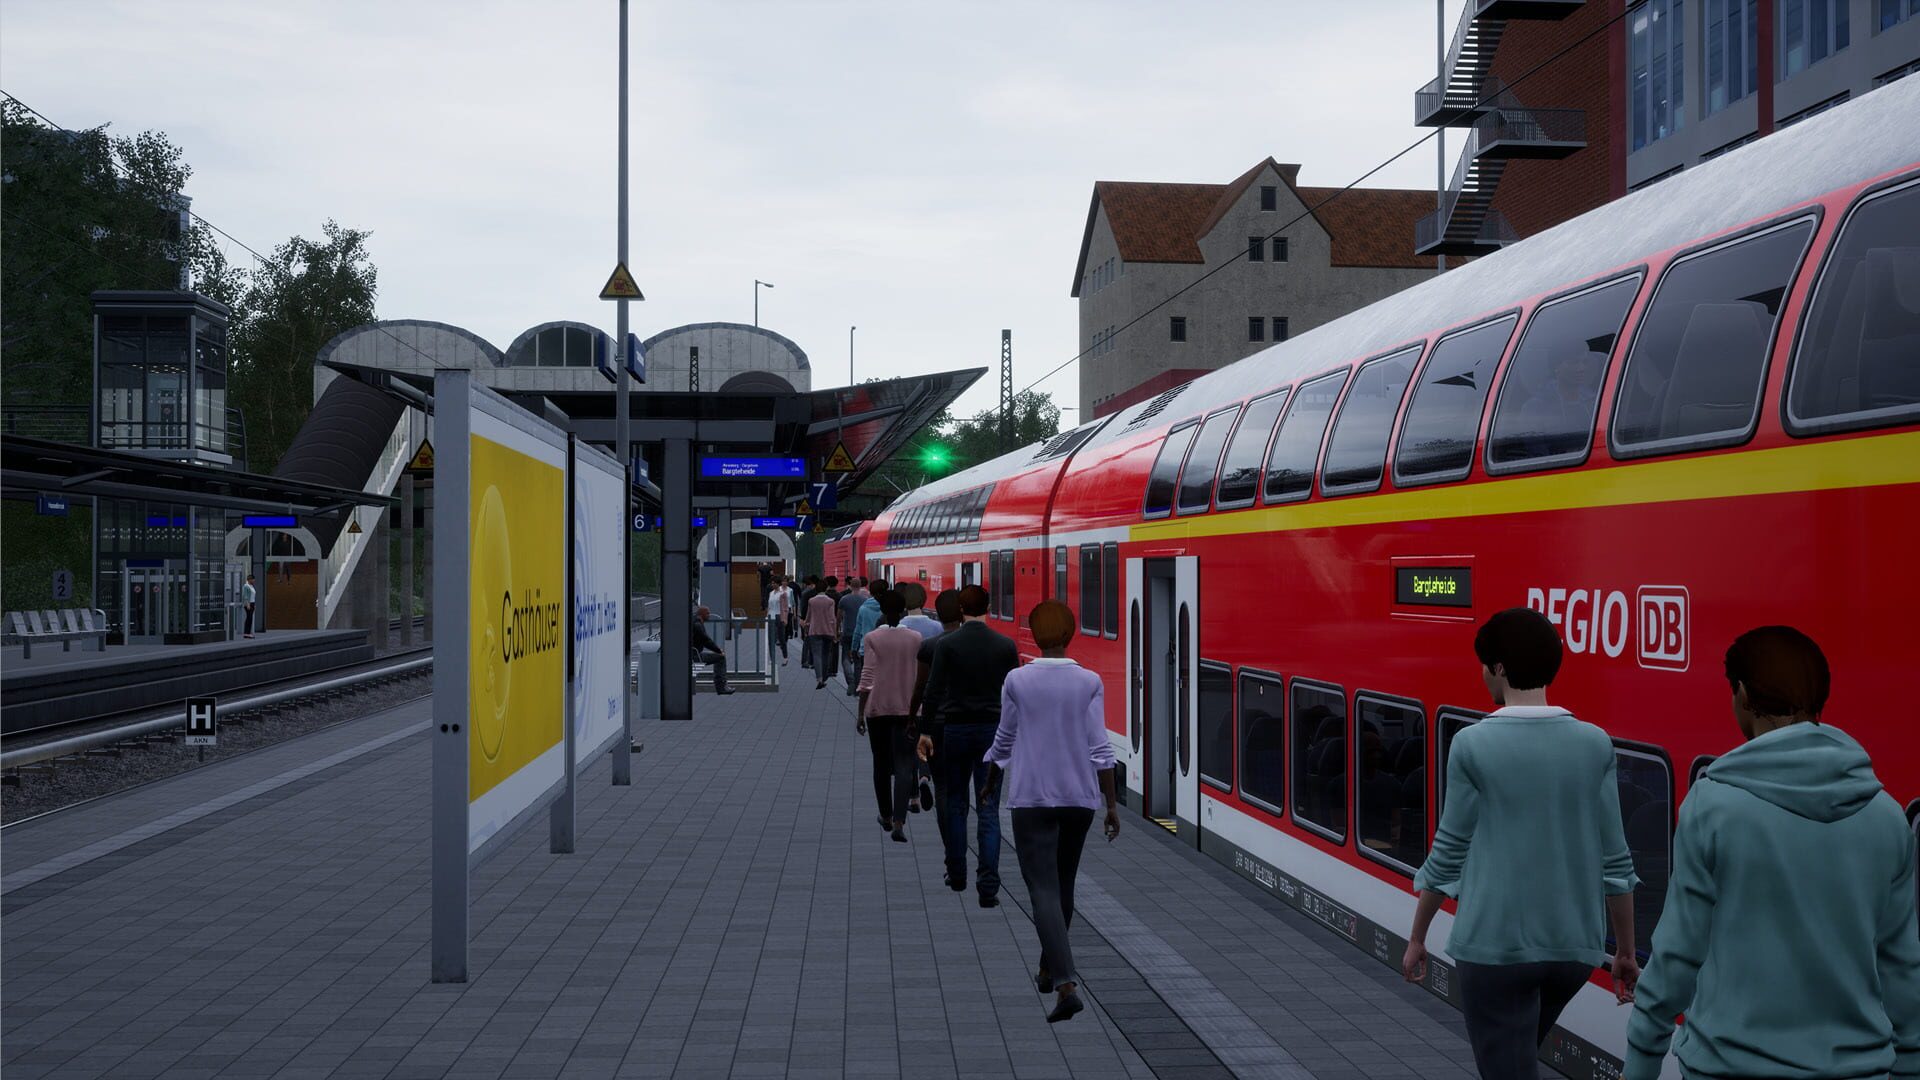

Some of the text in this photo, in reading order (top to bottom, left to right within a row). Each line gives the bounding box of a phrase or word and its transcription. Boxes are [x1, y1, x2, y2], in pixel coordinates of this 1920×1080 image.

[813, 483, 828, 506] 7
[633, 514, 645, 530] 6
[797, 514, 806, 530] 7
[57, 573, 66, 584] 4
[1413, 576, 1456, 597] Bargteheide
[57, 585, 66, 597] 2
[502, 588, 560, 664] Gasthäuser
[1642, 598, 1685, 658] DB
[191, 704, 211, 729] H
